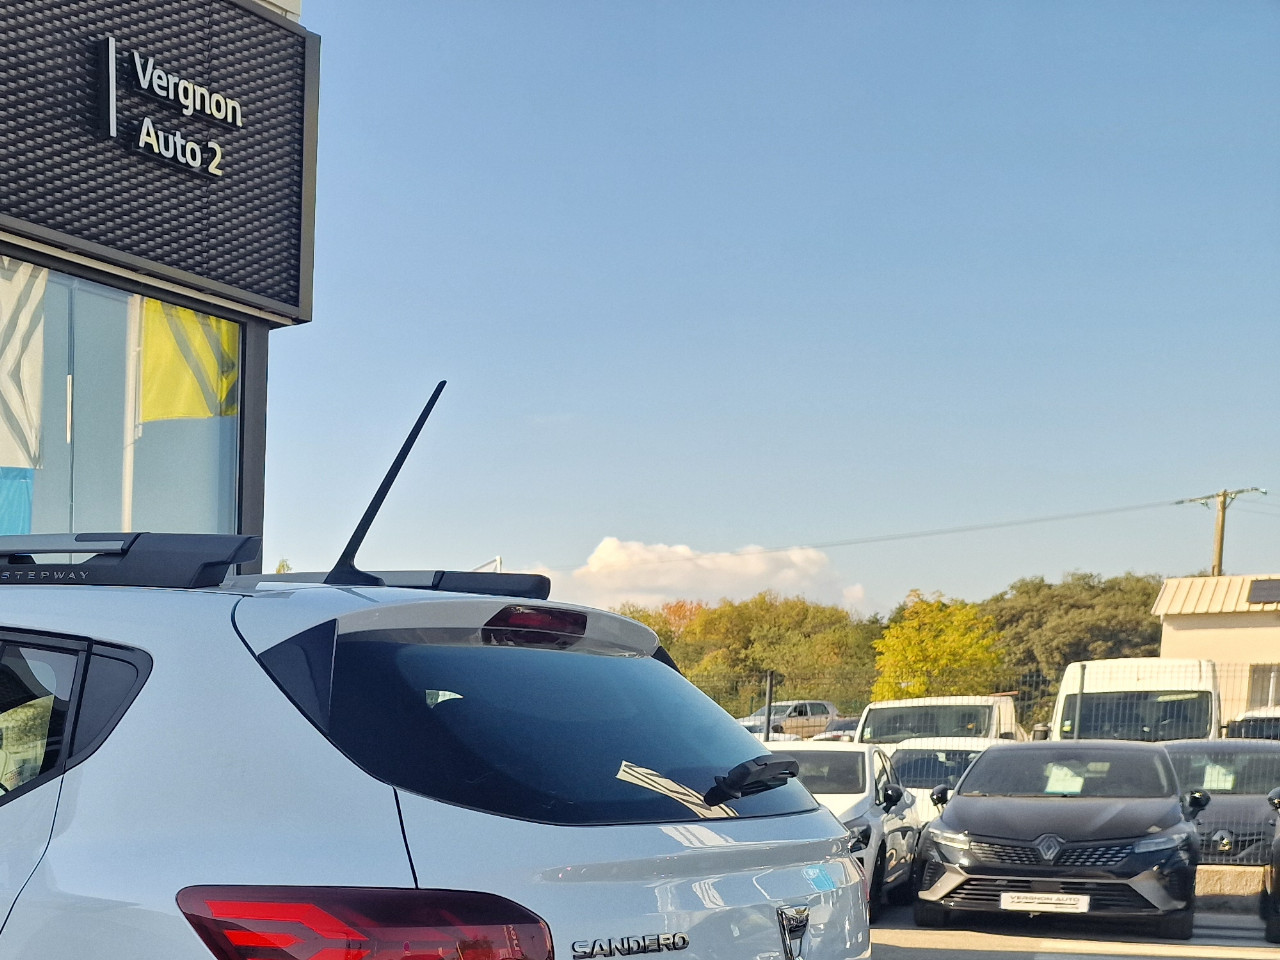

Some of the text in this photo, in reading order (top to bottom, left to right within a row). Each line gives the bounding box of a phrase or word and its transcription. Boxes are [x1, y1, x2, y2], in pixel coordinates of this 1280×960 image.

[131, 51, 242, 127] Vergnon
[138, 117, 224, 176] Auto 2
[1, 571, 89, 579] STEPWAY
[571, 931, 690, 960] SANDERO
